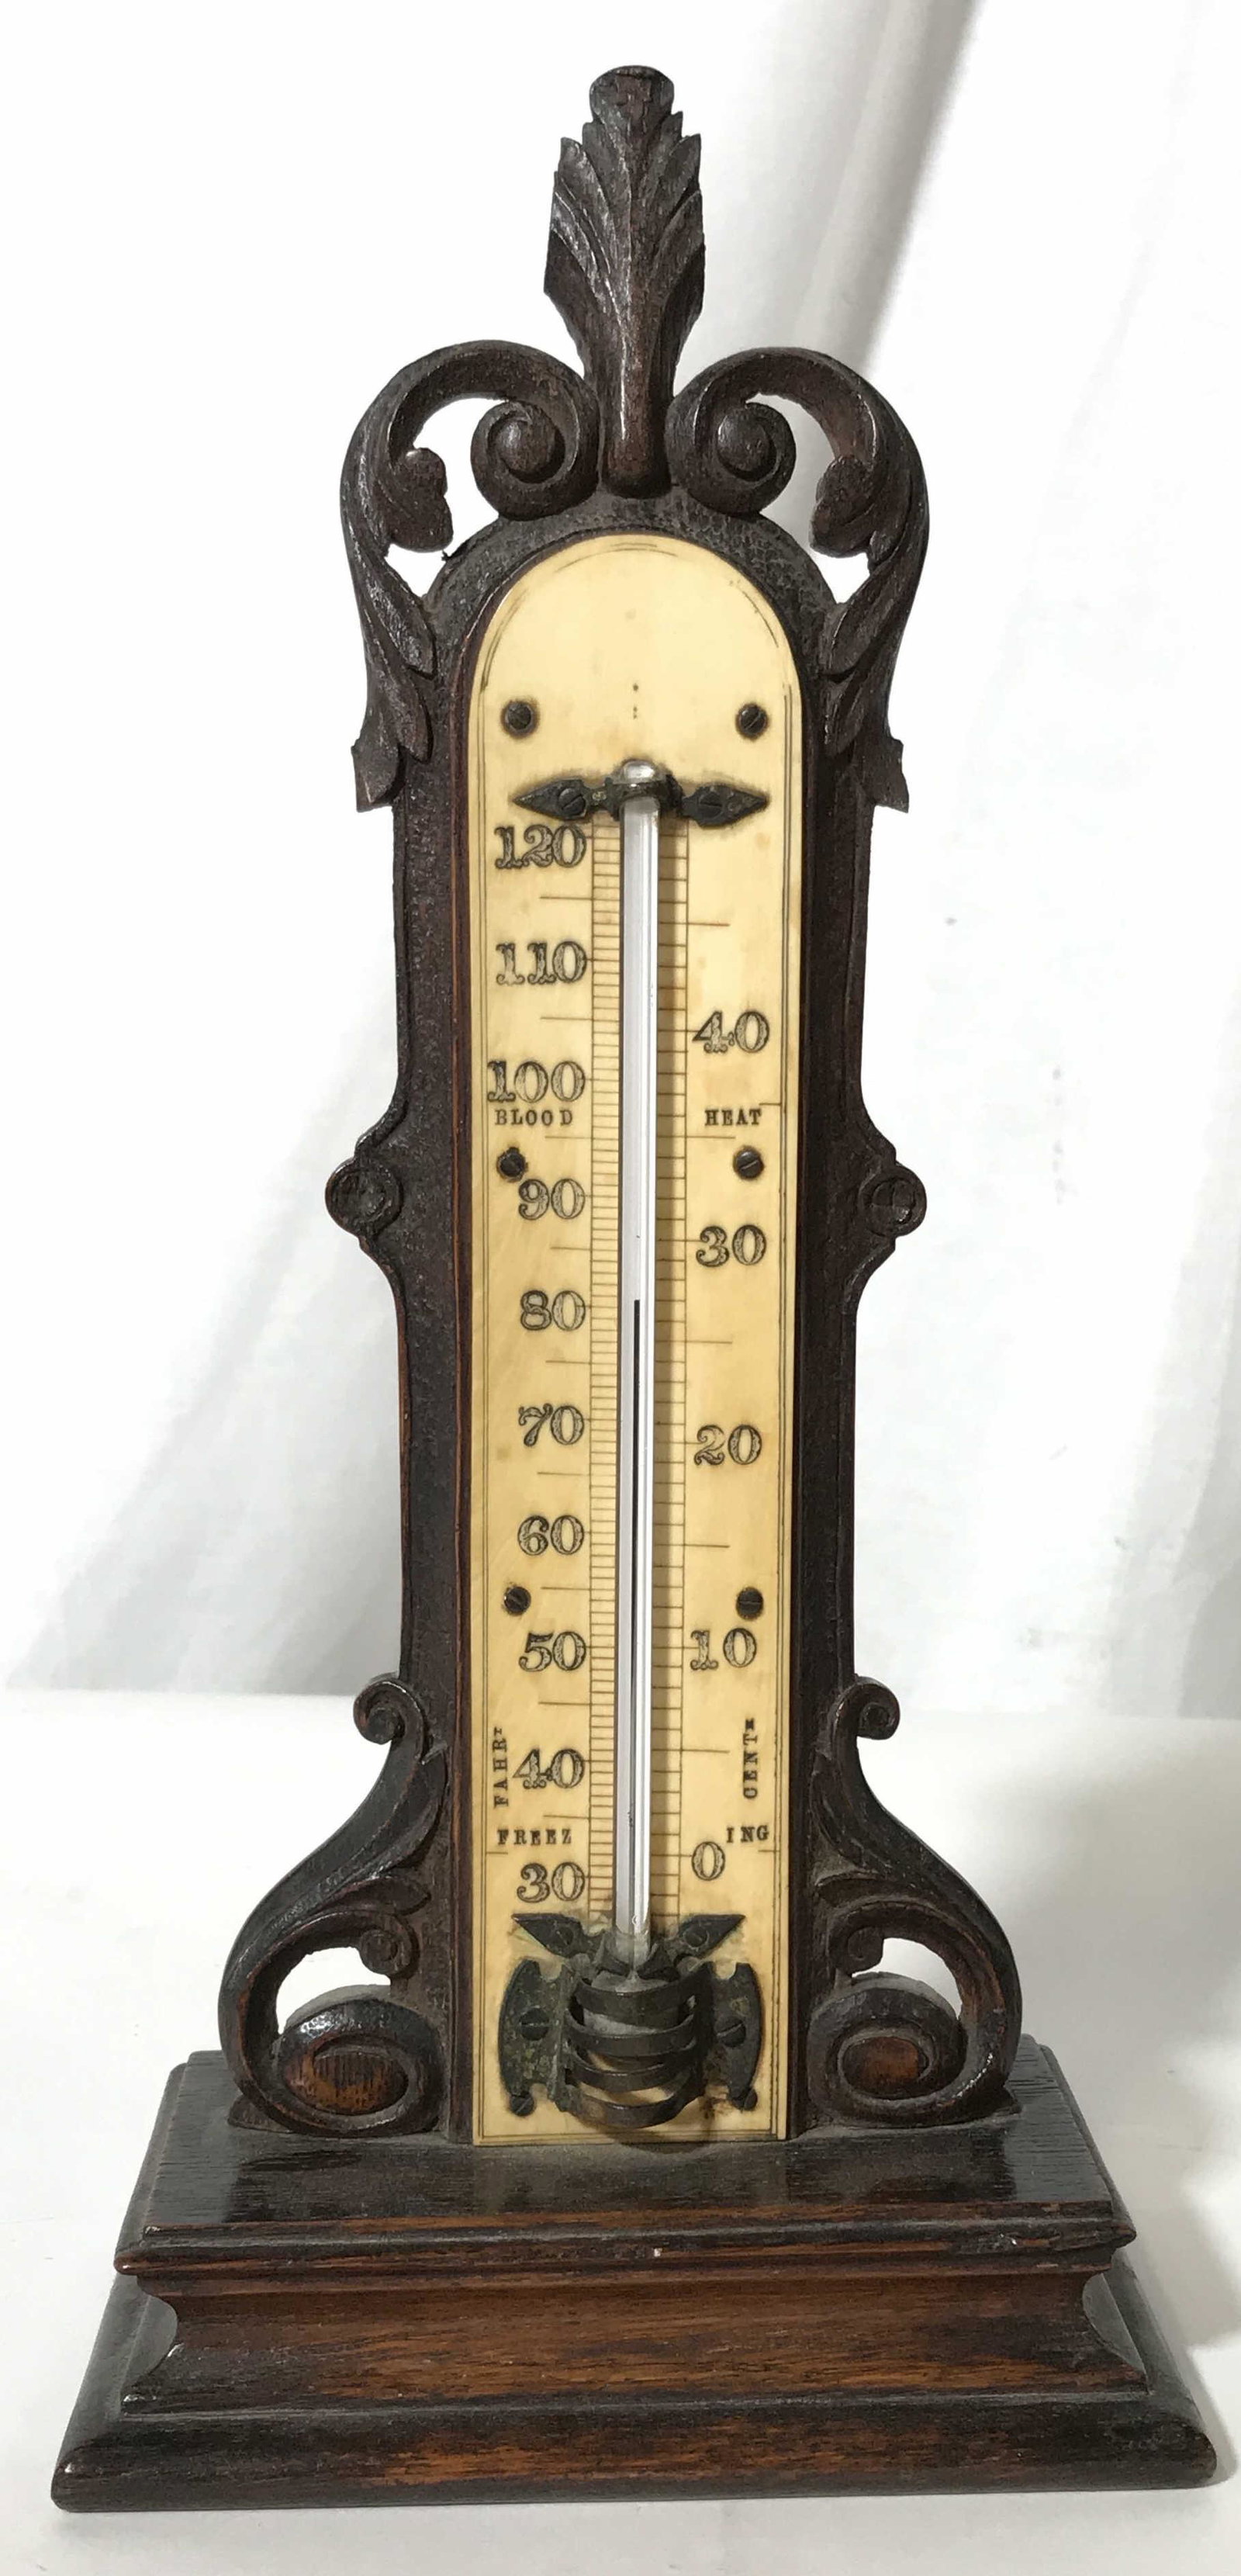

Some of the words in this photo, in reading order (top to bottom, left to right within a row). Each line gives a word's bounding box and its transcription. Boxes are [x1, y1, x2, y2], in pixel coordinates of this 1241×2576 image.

[494, 823, 587, 869] 120
[495, 940, 588, 985] 110
[692, 1009, 770, 1054] 40
[486, 1060, 586, 1103] 100
[494, 1109, 573, 1127] BLOOD
[704, 1108, 762, 1127] HEAT
[517, 1178, 586, 1220] 90
[695, 1224, 767, 1268] 30
[520, 1290, 586, 1331] 80
[517, 1402, 585, 1448] 70
[693, 1424, 762, 1466] 20
[517, 1515, 585, 1556] 60
[518, 1630, 586, 1672] 50
[690, 1627, 758, 1671] 10
[512, 1747, 585, 1790] 40
[496, 1828, 572, 1846] FREEZ
[726, 1824, 769, 1844] ING
[516, 1861, 586, 1903] 30
[691, 1840, 726, 1882] 0
